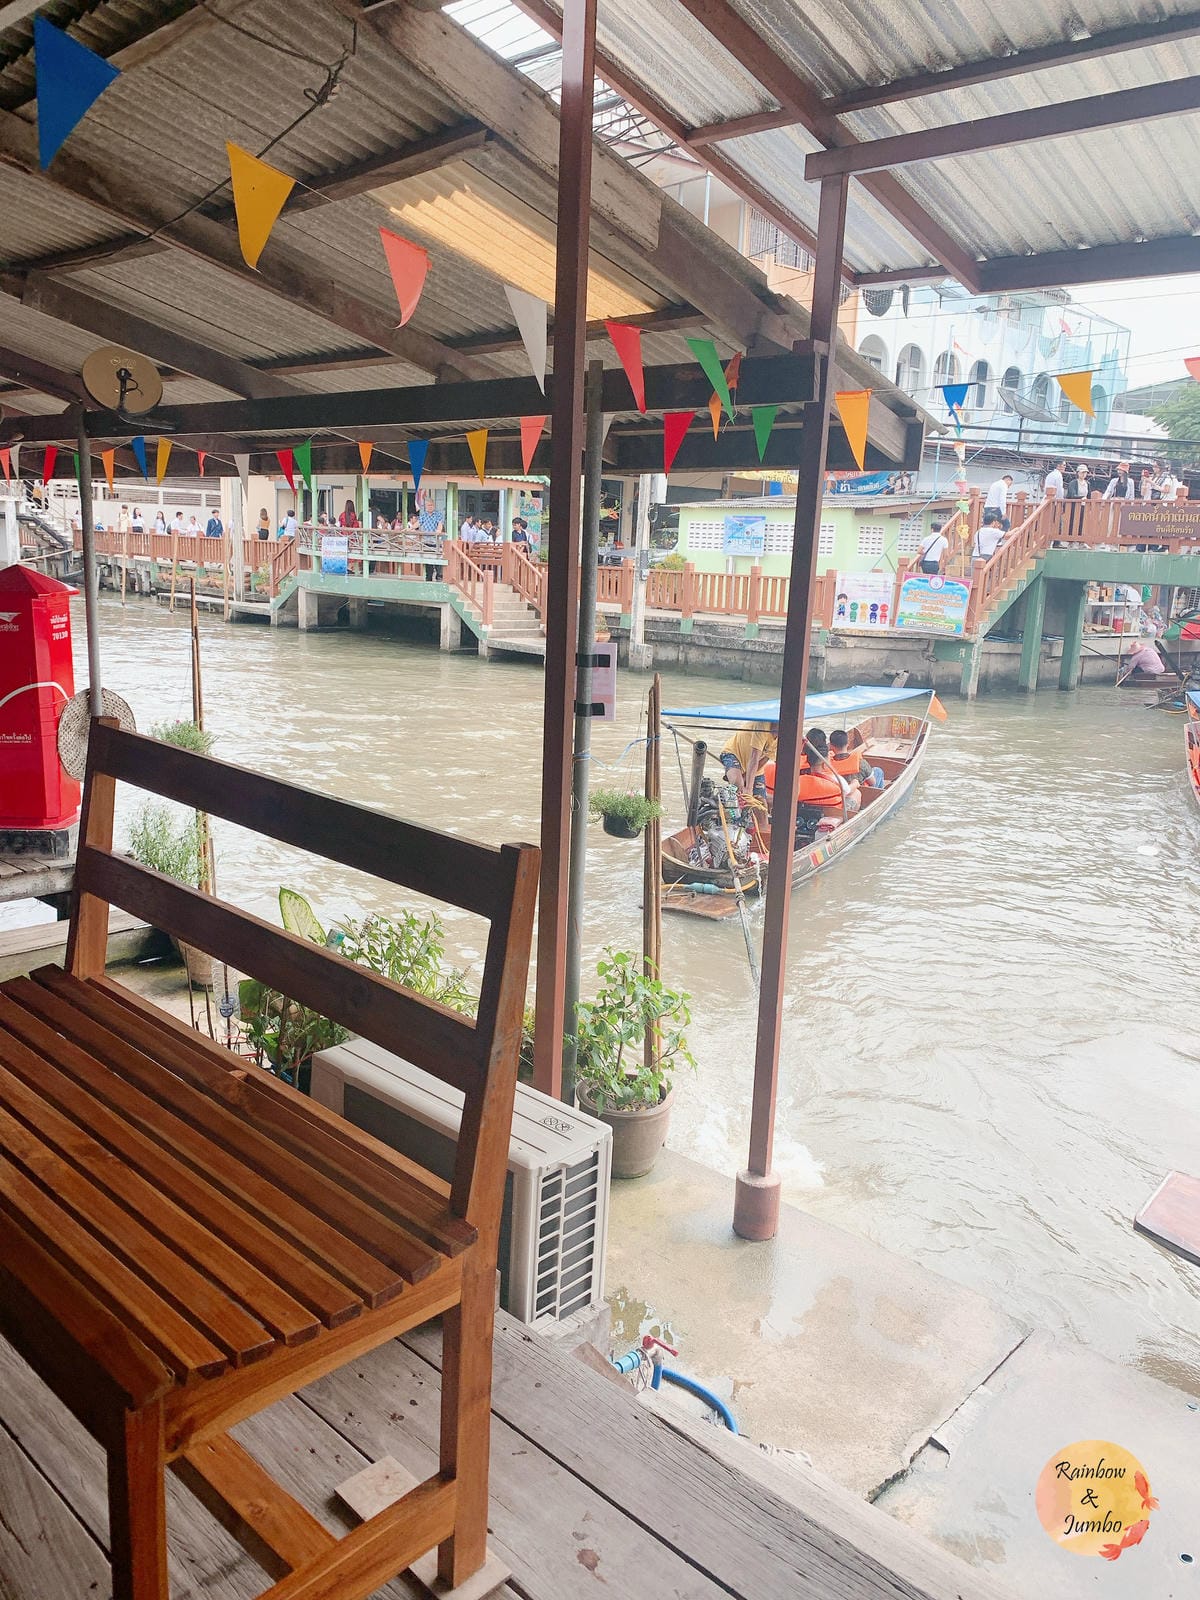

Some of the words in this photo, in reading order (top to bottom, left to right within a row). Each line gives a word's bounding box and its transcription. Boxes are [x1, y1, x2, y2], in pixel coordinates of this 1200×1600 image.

[1128, 505, 1200, 523] ตลาดน้ำดำเนินส
